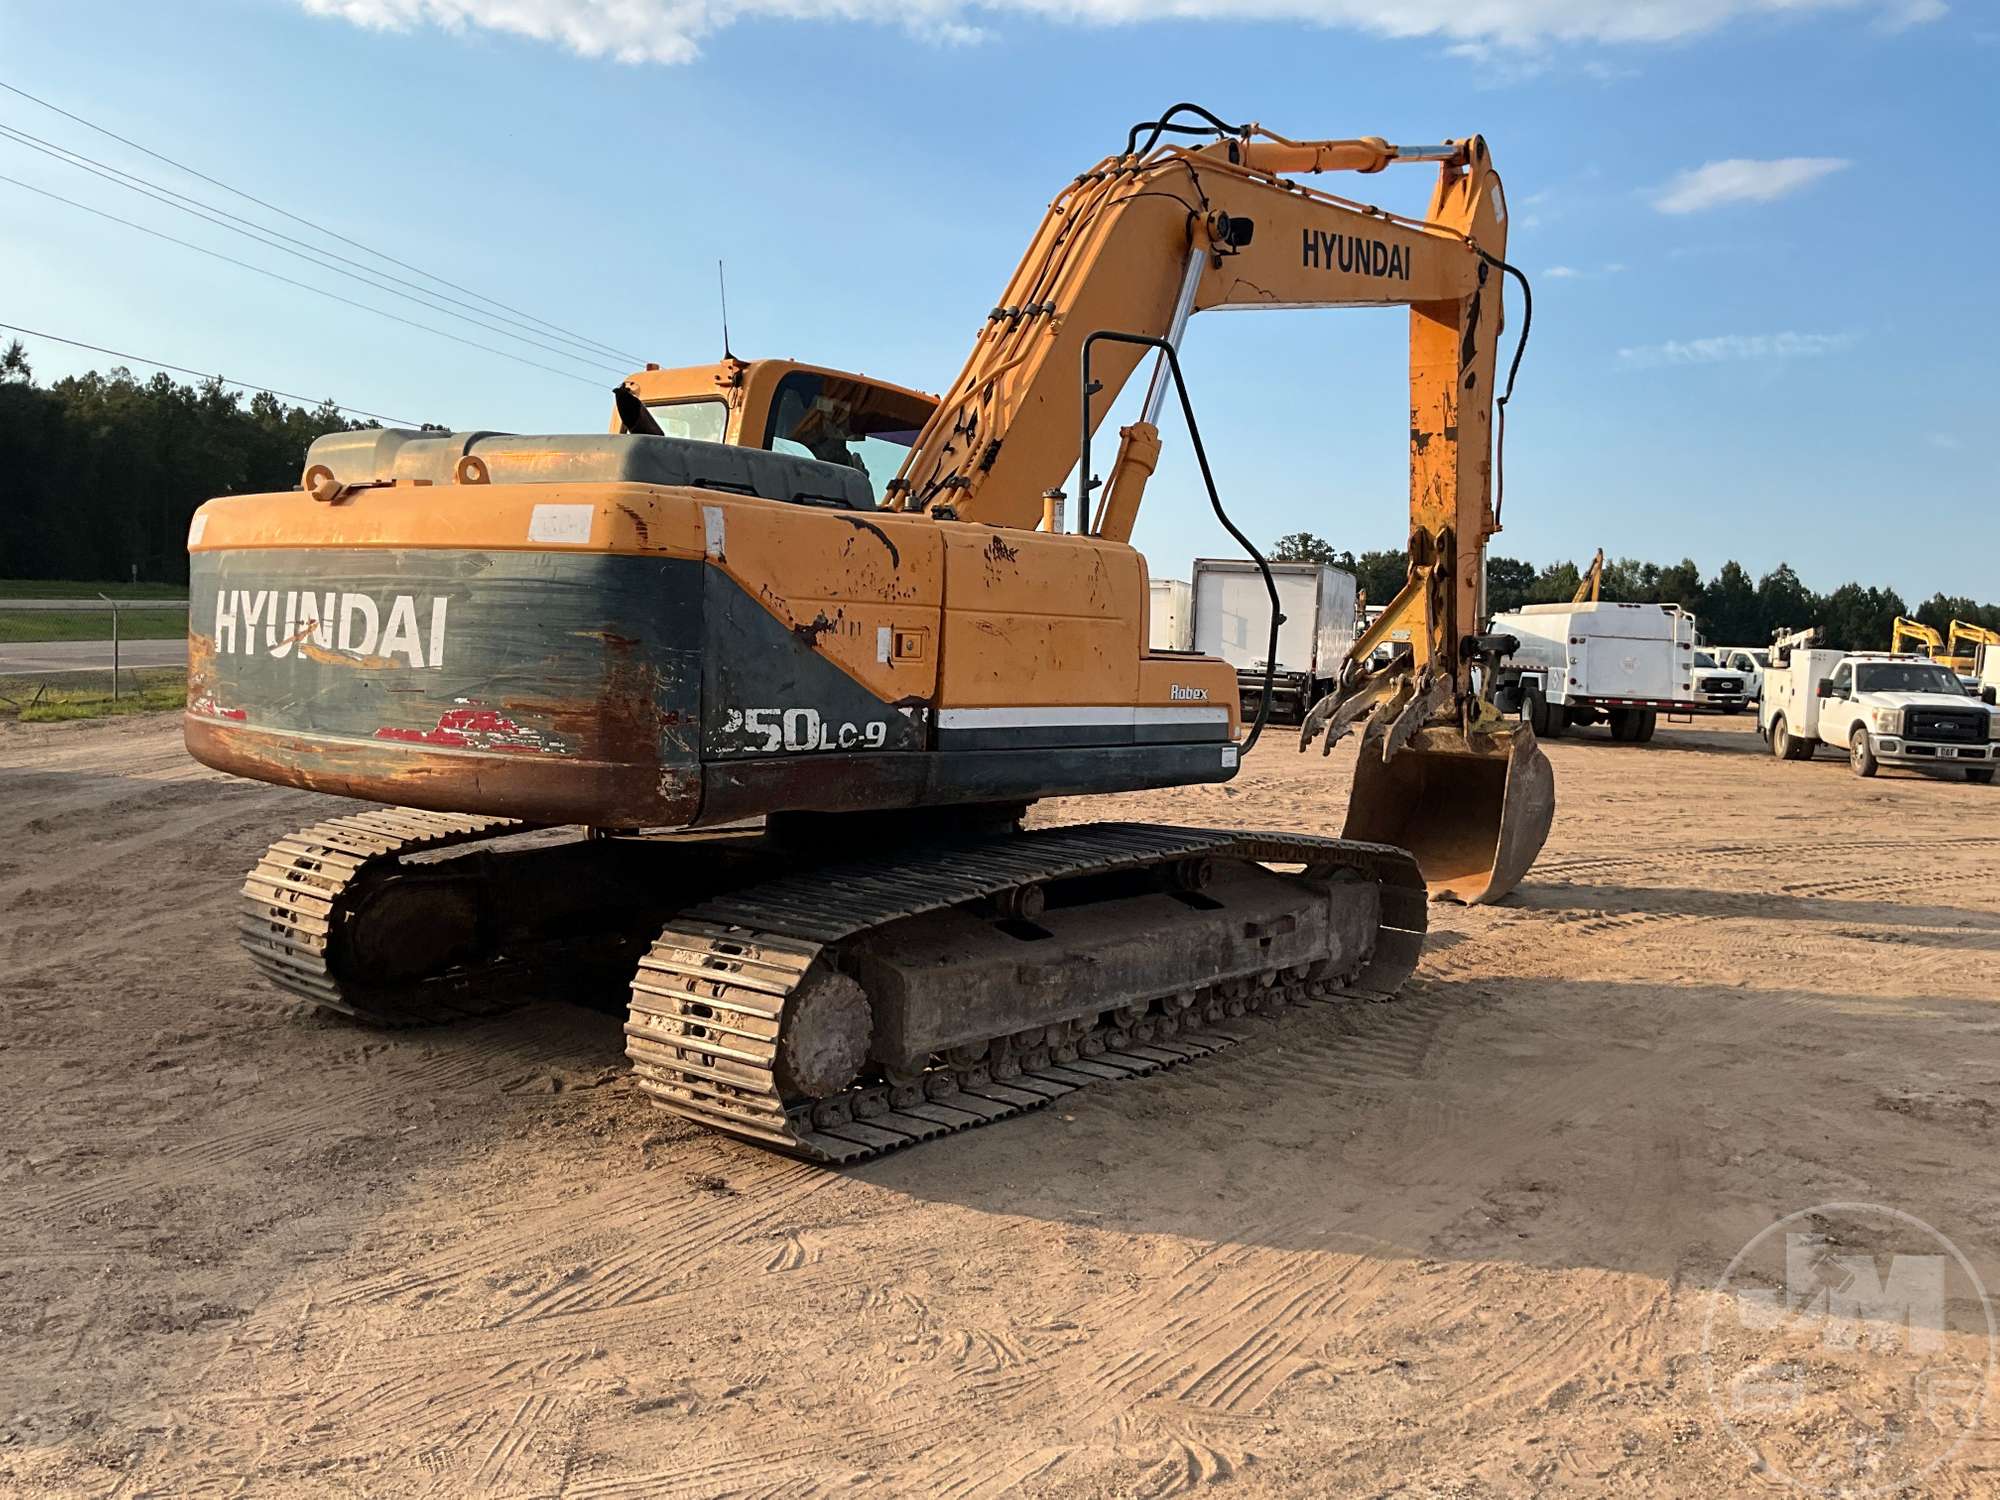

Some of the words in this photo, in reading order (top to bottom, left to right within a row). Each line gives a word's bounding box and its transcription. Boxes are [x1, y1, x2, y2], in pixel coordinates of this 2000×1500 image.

[1302, 228, 1411, 281] HYUNDAI
[213, 589, 449, 669] HYUNDAI
[1170, 684, 1209, 700] Robex
